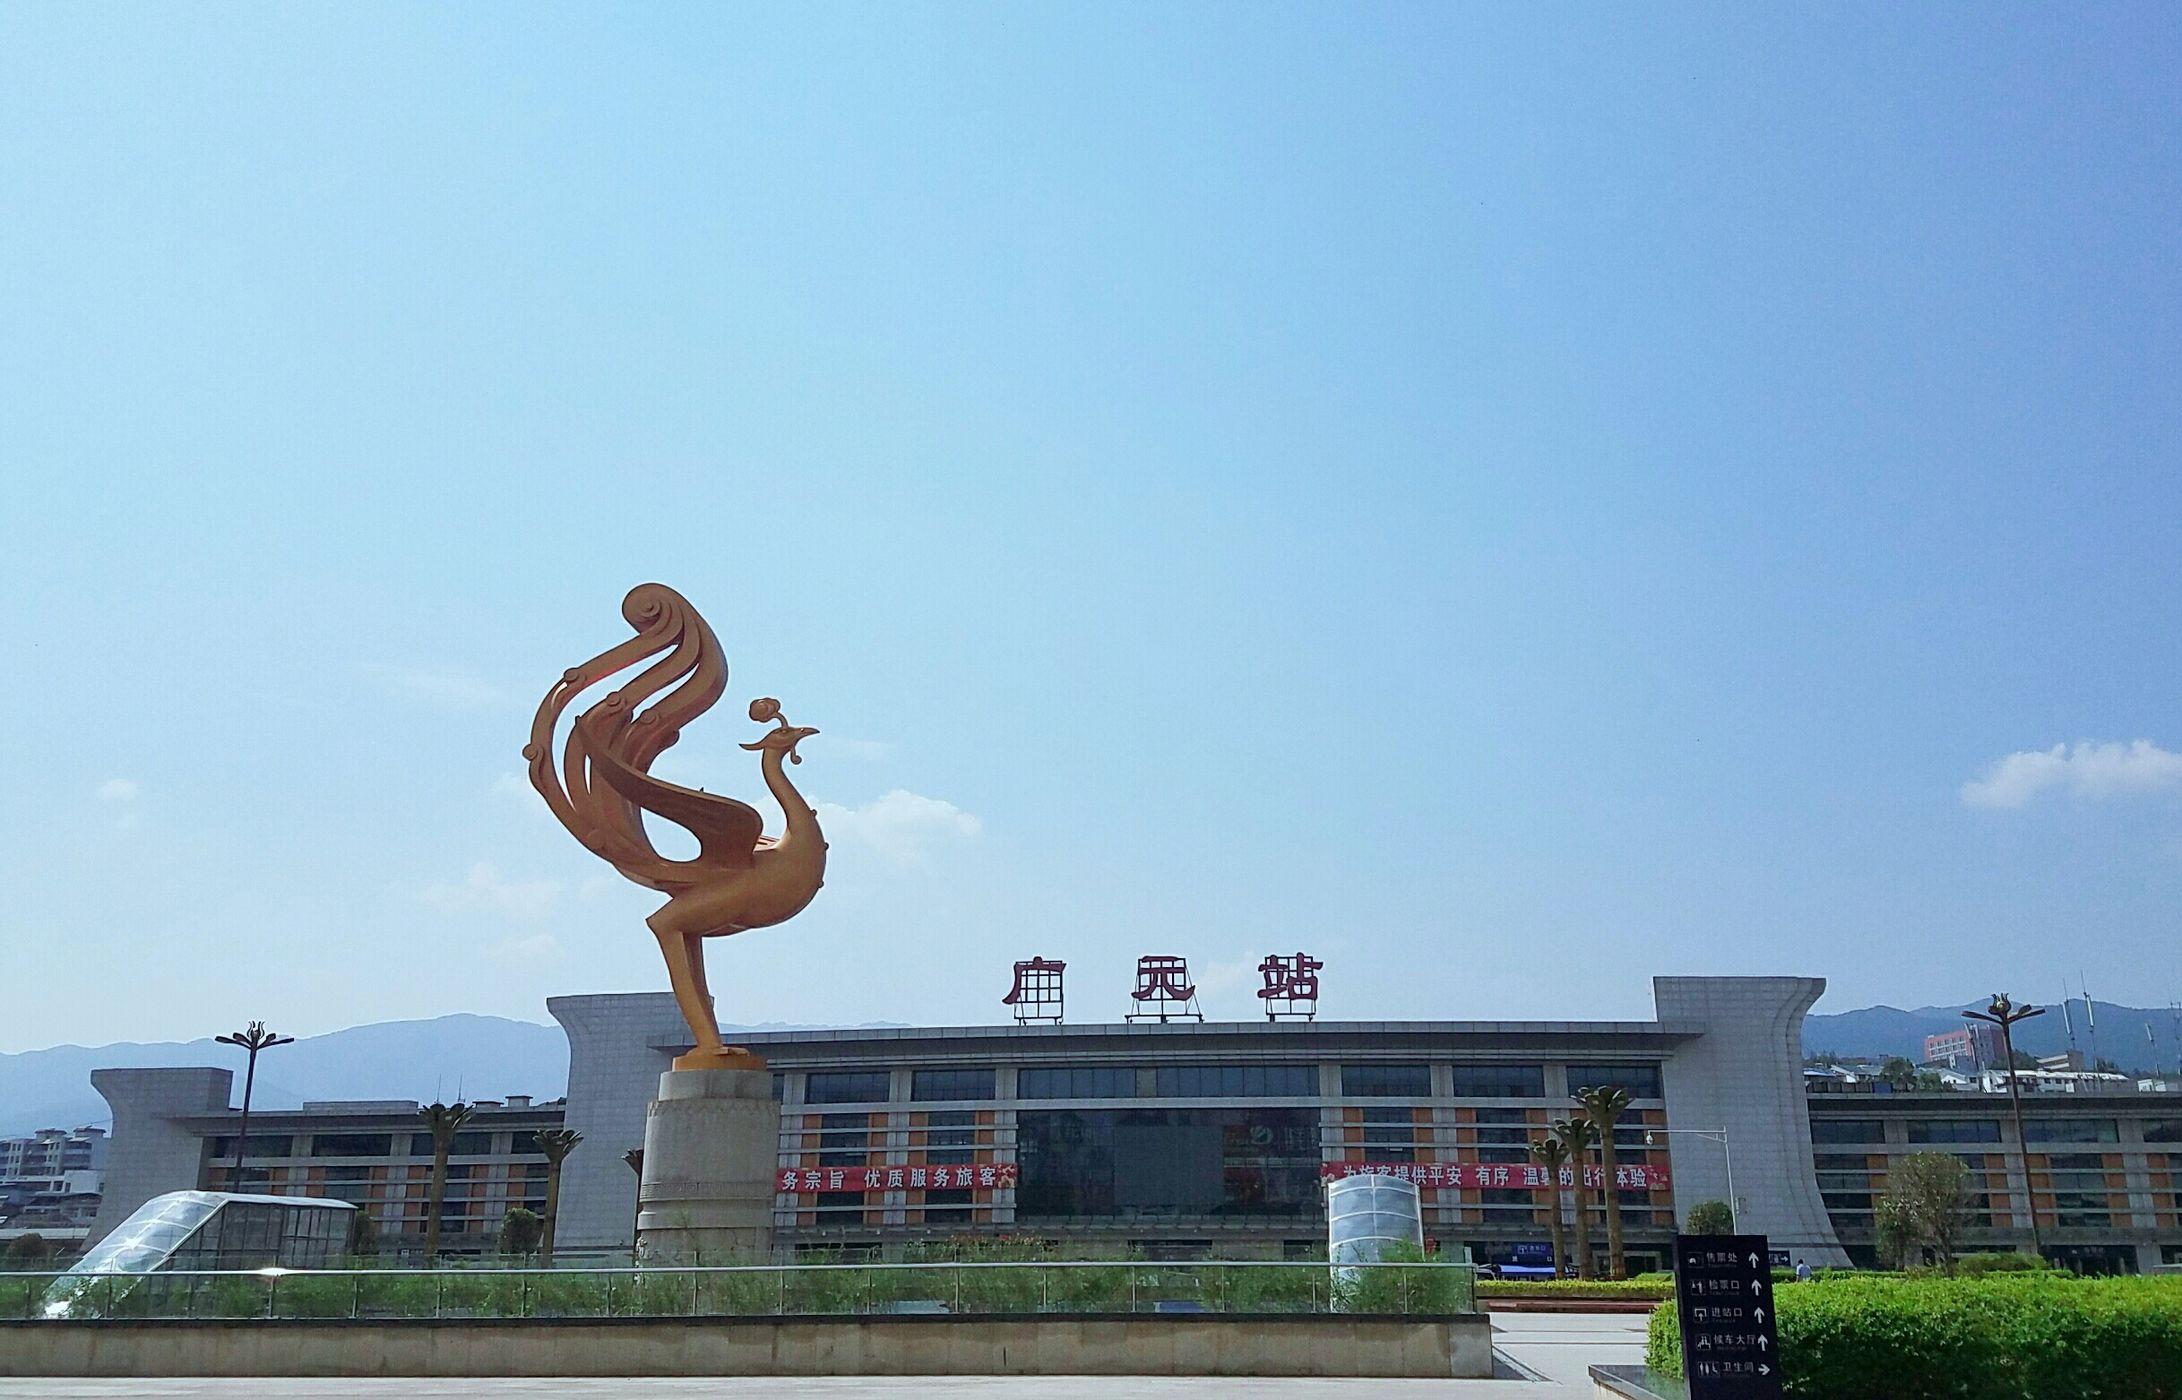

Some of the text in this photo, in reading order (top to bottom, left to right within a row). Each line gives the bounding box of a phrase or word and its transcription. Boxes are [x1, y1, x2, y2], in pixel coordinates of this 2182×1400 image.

[1002, 952, 1323, 1004] 广元站
[782, 1166, 996, 1190] 务宗旨 优质服务旅客
[1476, 1166, 1508, 1186] 有序
[1712, 1307, 1742, 1317] 进站口
[1714, 1334, 1755, 1345] 候车大厅
[1722, 1361, 1754, 1372] 卫生间
